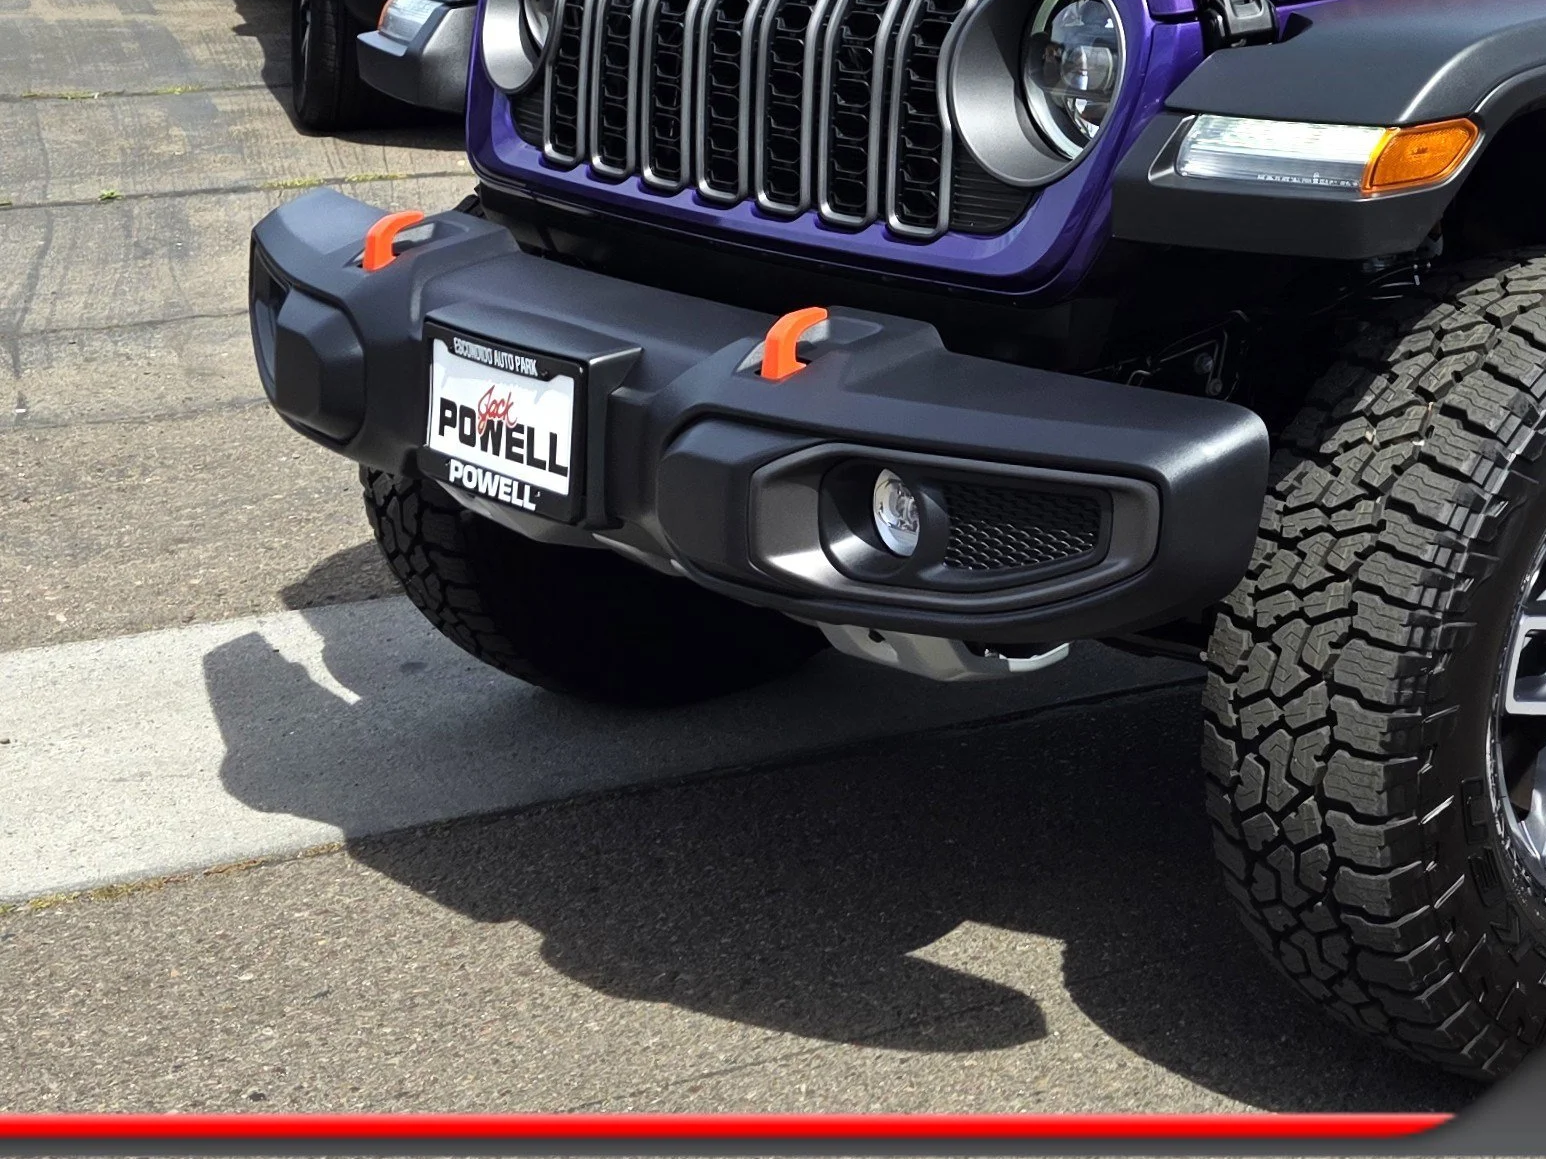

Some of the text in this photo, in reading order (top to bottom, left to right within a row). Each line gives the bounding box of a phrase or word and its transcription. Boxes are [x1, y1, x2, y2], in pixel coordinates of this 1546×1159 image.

[493, 349, 515, 371] AUTO
[514, 355, 538, 377] PARK
[478, 385, 517, 436] Jack
[438, 396, 569, 478] POWELL
[449, 458, 537, 512] POWELL
